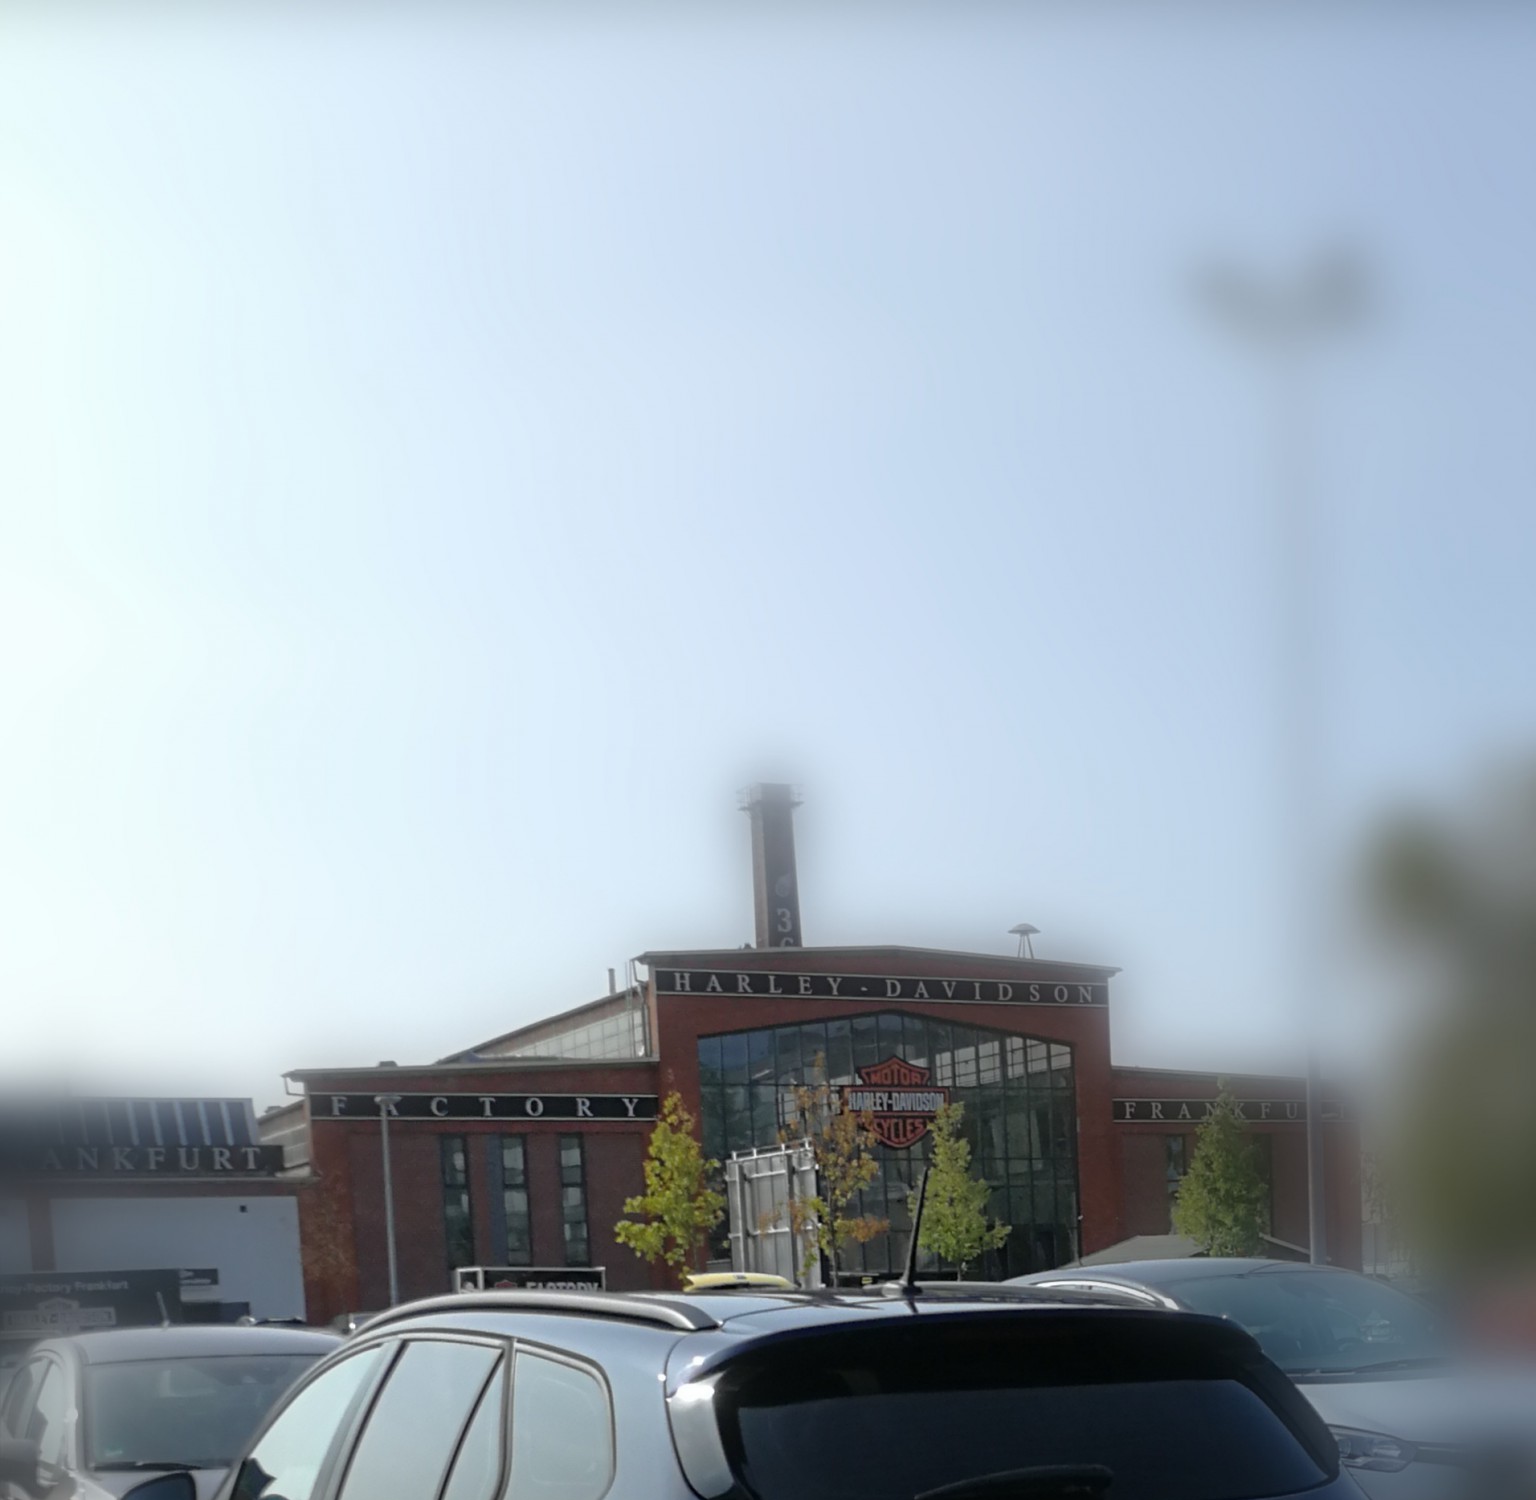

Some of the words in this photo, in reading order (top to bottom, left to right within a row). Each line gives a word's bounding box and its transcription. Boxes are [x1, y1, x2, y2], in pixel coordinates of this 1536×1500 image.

[870, 1064, 922, 1085] MOTOR
[847, 1090, 945, 1112] HARLEY-DAVIDSON
[1124, 1101, 1349, 1120] FRANKFUT
[873, 1119, 925, 1141] CYCLES
